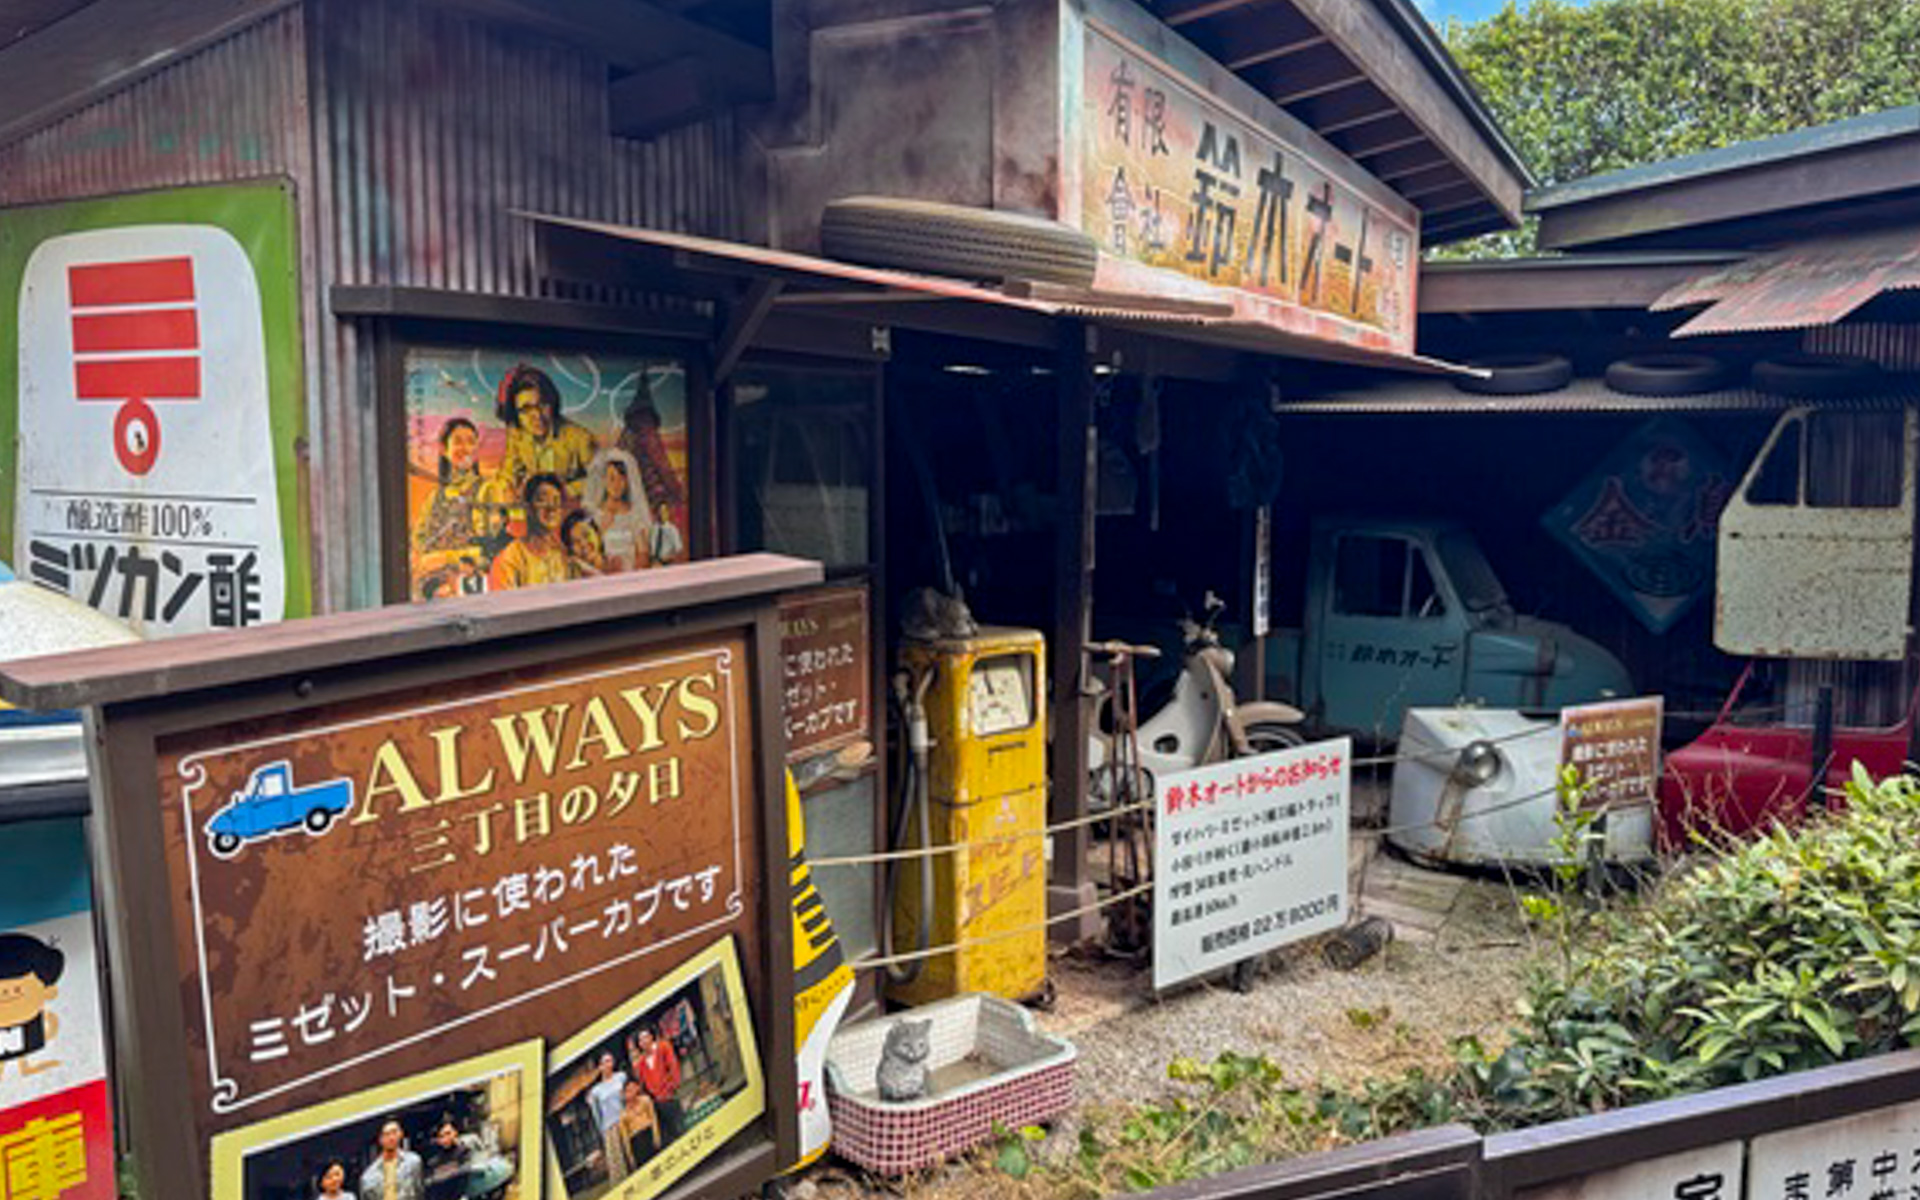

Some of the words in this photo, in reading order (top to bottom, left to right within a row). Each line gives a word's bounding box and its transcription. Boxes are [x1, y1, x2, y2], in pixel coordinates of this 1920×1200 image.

[1186, 121, 1373, 314] 鈴木オート
[30, 539, 262, 627] ミツカン酢
[350, 672, 721, 826] ALWAYS
[410, 756, 681, 874] 三丁目の夕日
[363, 844, 639, 961] 撮影に使われた
